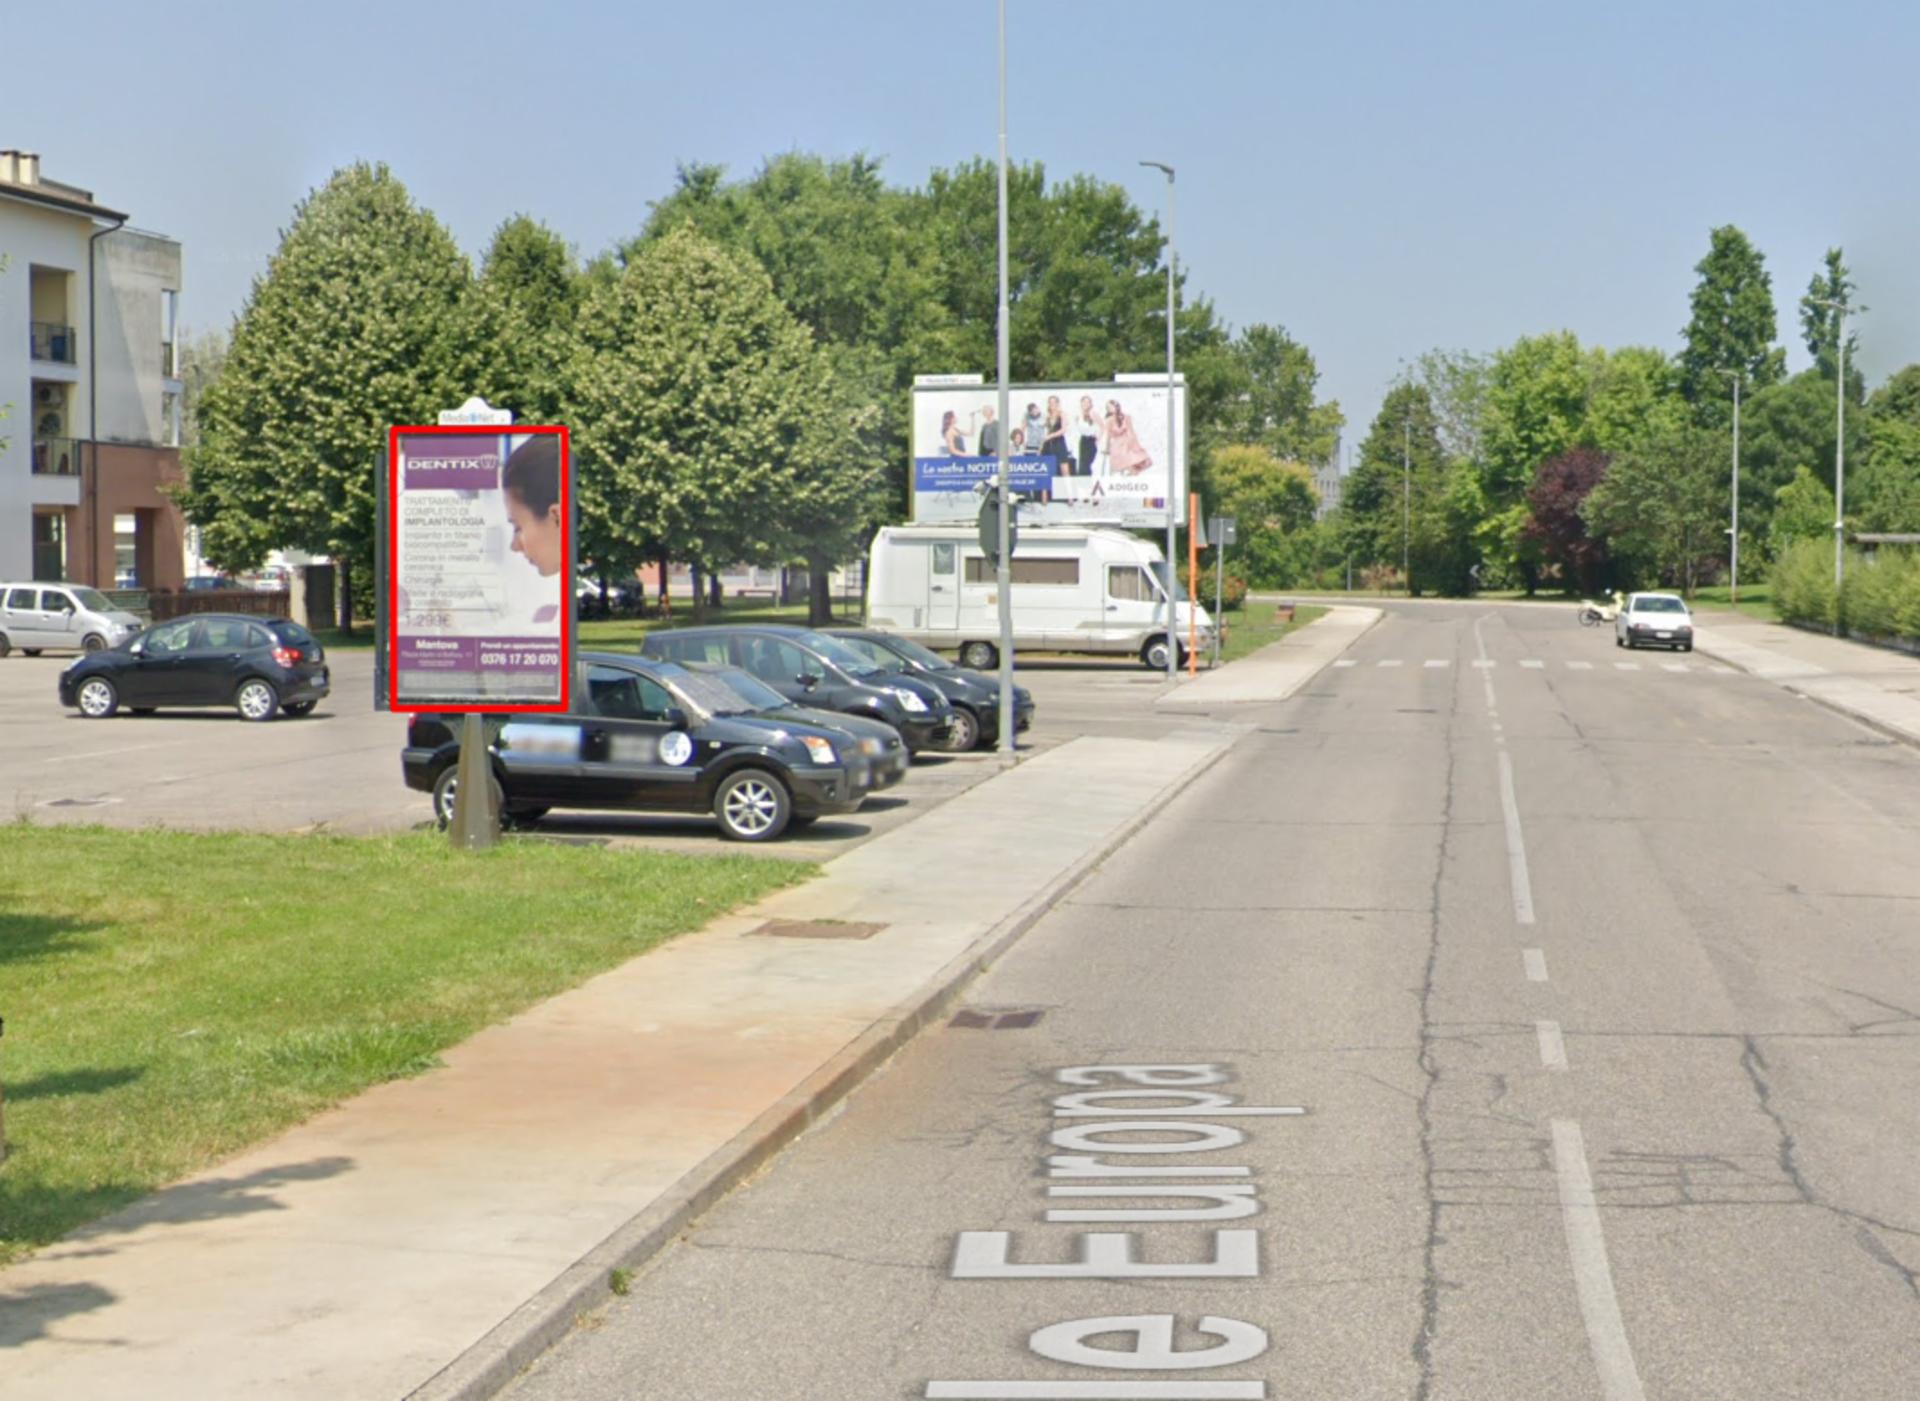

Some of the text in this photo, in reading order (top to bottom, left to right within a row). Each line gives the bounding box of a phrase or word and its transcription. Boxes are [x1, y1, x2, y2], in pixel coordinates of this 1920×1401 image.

[407, 459, 480, 470] DENTIX
[1107, 482, 1149, 492] ADIGEO
[404, 507, 457, 516] COMPLETO
[404, 518, 485, 526] IMPLANTOLOGIA
[415, 639, 459, 650] Mantova
[480, 653, 506, 665] 0376
[509, 653, 521, 664] 17
[523, 653, 536, 664] 20
[538, 653, 559, 664] 070
[952, 1064, 1305, 1278] Europa
